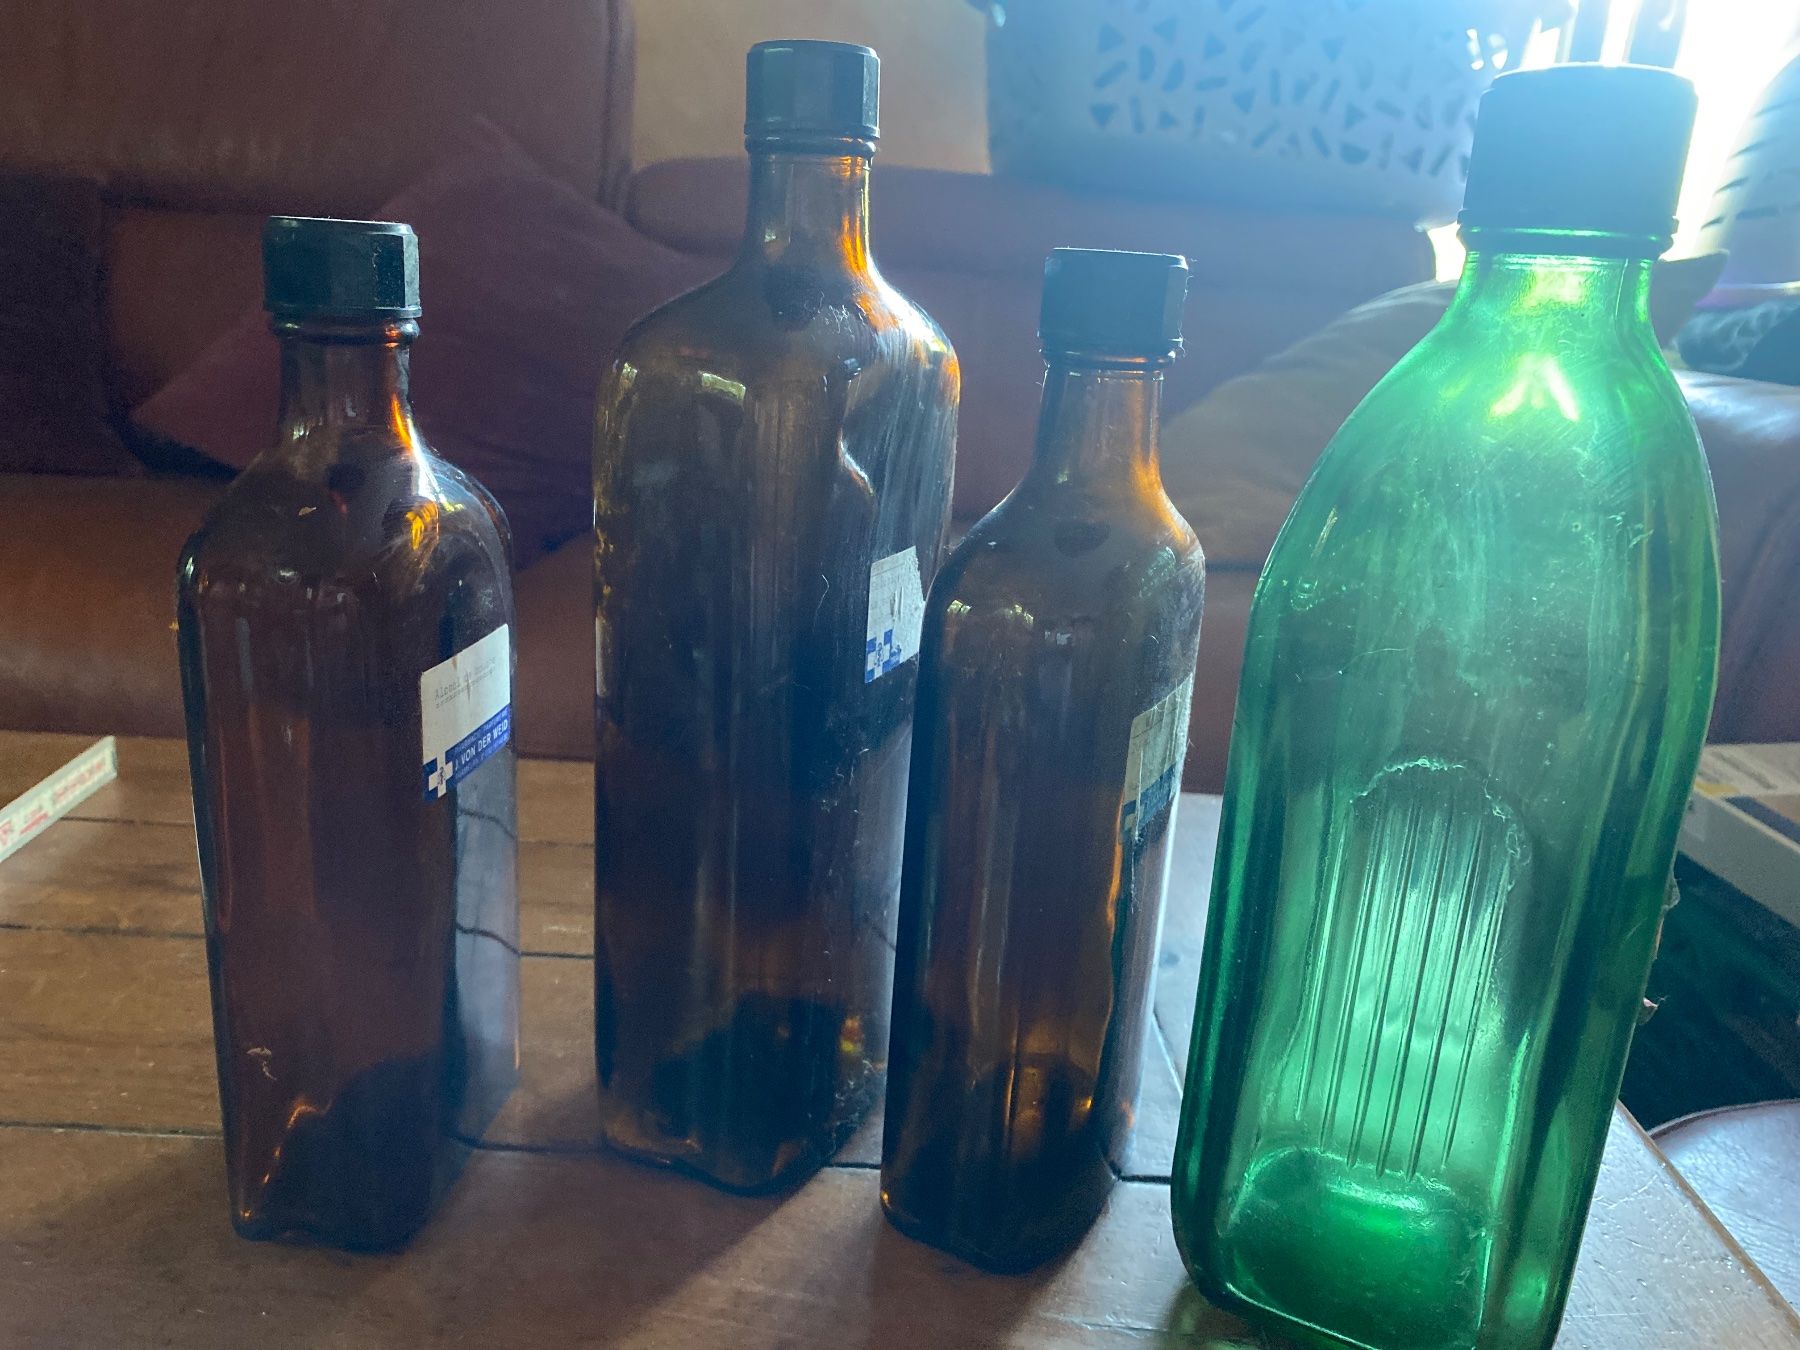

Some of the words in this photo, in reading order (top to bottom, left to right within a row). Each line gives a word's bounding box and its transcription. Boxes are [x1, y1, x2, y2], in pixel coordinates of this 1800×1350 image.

[461, 745, 476, 764] VON
[478, 733, 491, 751] DER
[492, 719, 508, 740] WEID
